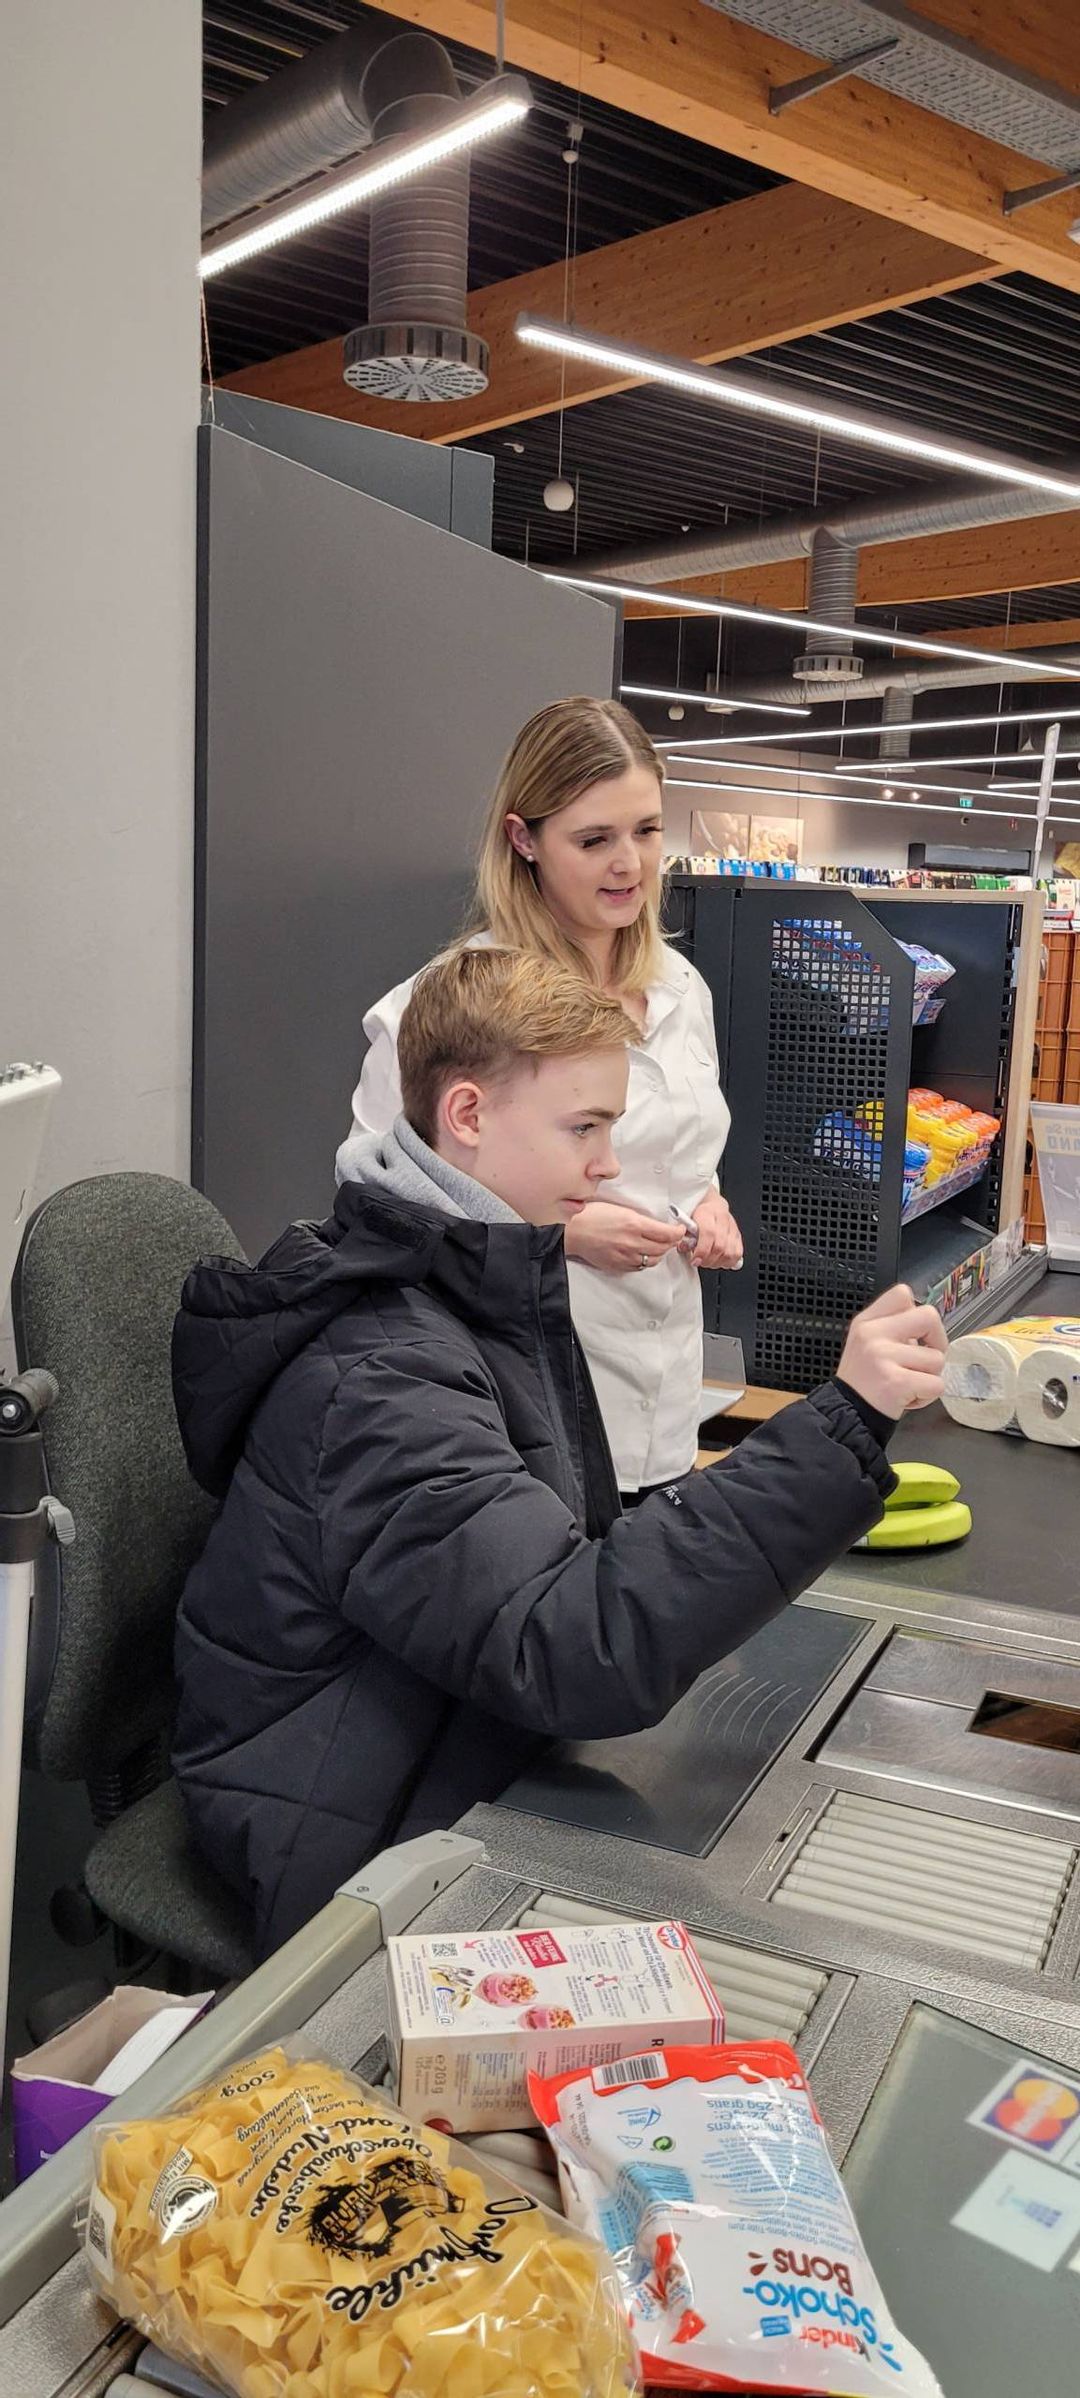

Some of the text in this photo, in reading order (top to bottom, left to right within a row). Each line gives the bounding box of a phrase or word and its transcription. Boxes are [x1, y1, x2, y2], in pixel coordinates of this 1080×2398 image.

[220, 2070, 275, 2098] 500g
[277, 2137, 432, 2232] Oberschwäbische
[326, 2196, 537, 2321] Dorfmühle
[772, 2248, 853, 2297] Bons
[743, 2280, 877, 2344] Schoko-
